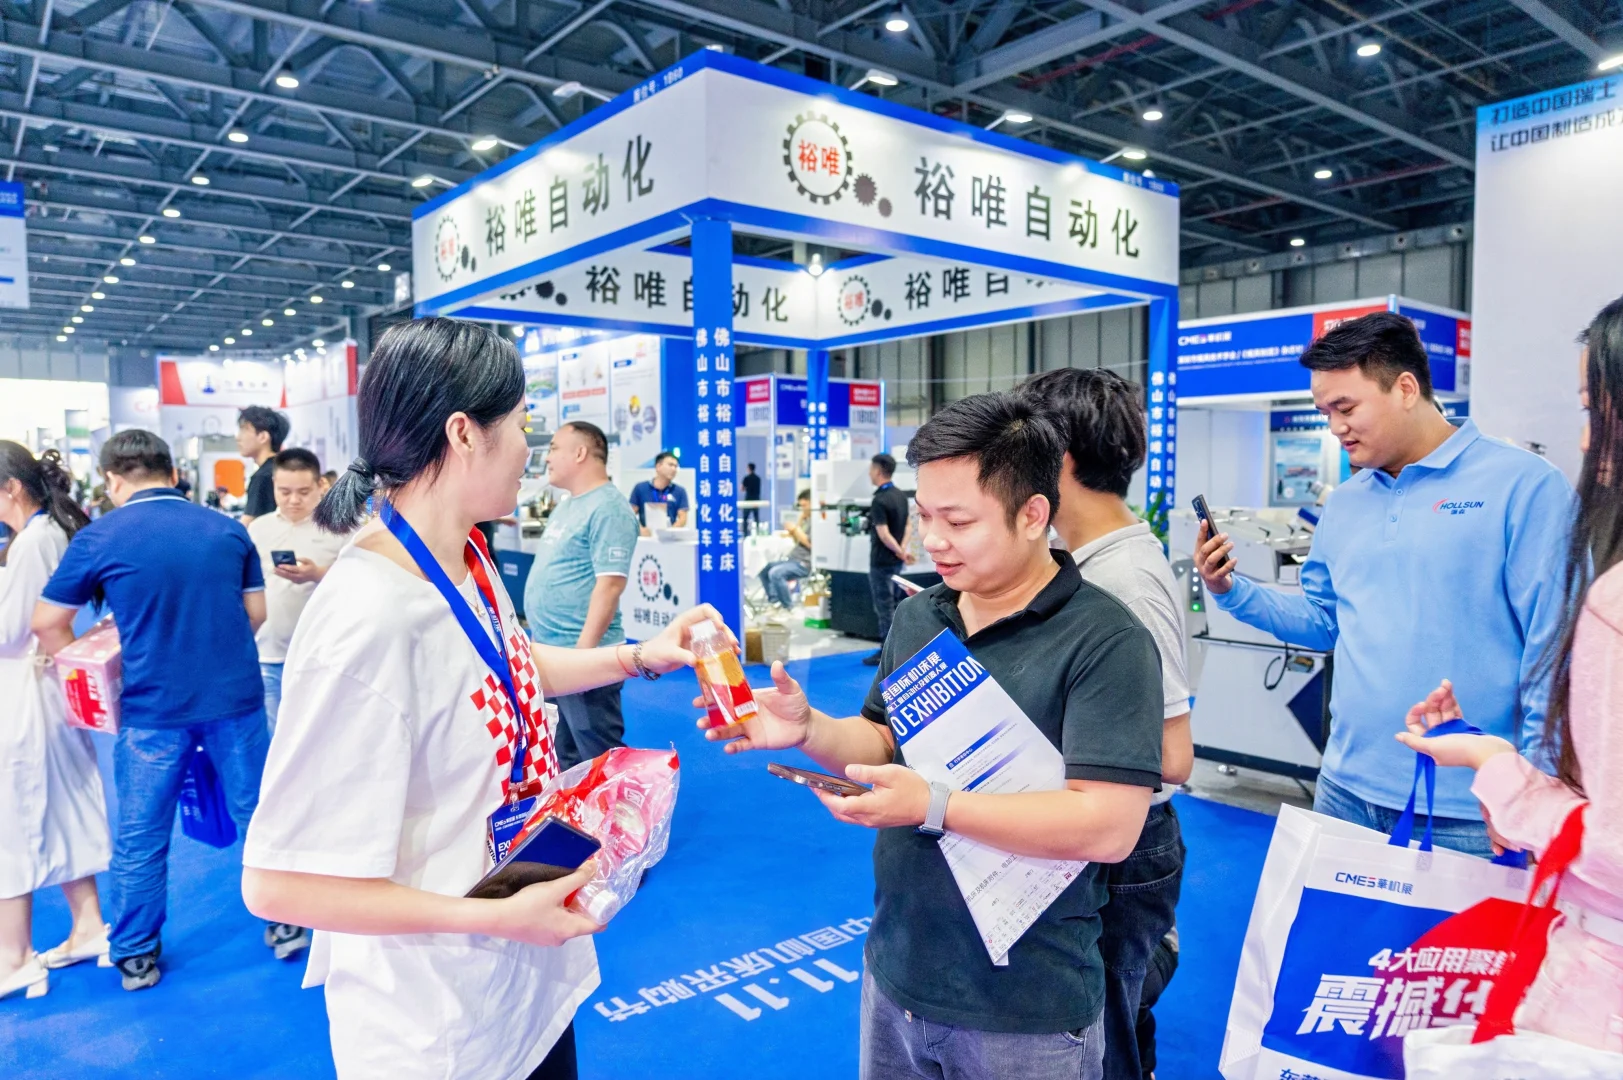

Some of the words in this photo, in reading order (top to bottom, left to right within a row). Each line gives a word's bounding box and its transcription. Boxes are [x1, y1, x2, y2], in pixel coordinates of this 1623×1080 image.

[485, 134, 655, 258] 裕唯自动化
[798, 139, 842, 177] 裕唯
[914, 156, 1140, 259] 裕唯自动化
[904, 266, 1054, 311] 裕唯自
[696, 328, 713, 572] 佛山市裕唯自动化车床
[714, 327, 735, 572] 佛山市裕唯自动化车床
[1440, 501, 1485, 510] HOLLSUN
[900, 655, 986, 727] EXHIBITION
[594, 916, 872, 1022] 中国机床采购节
[714, 958, 859, 1021] 11.11
